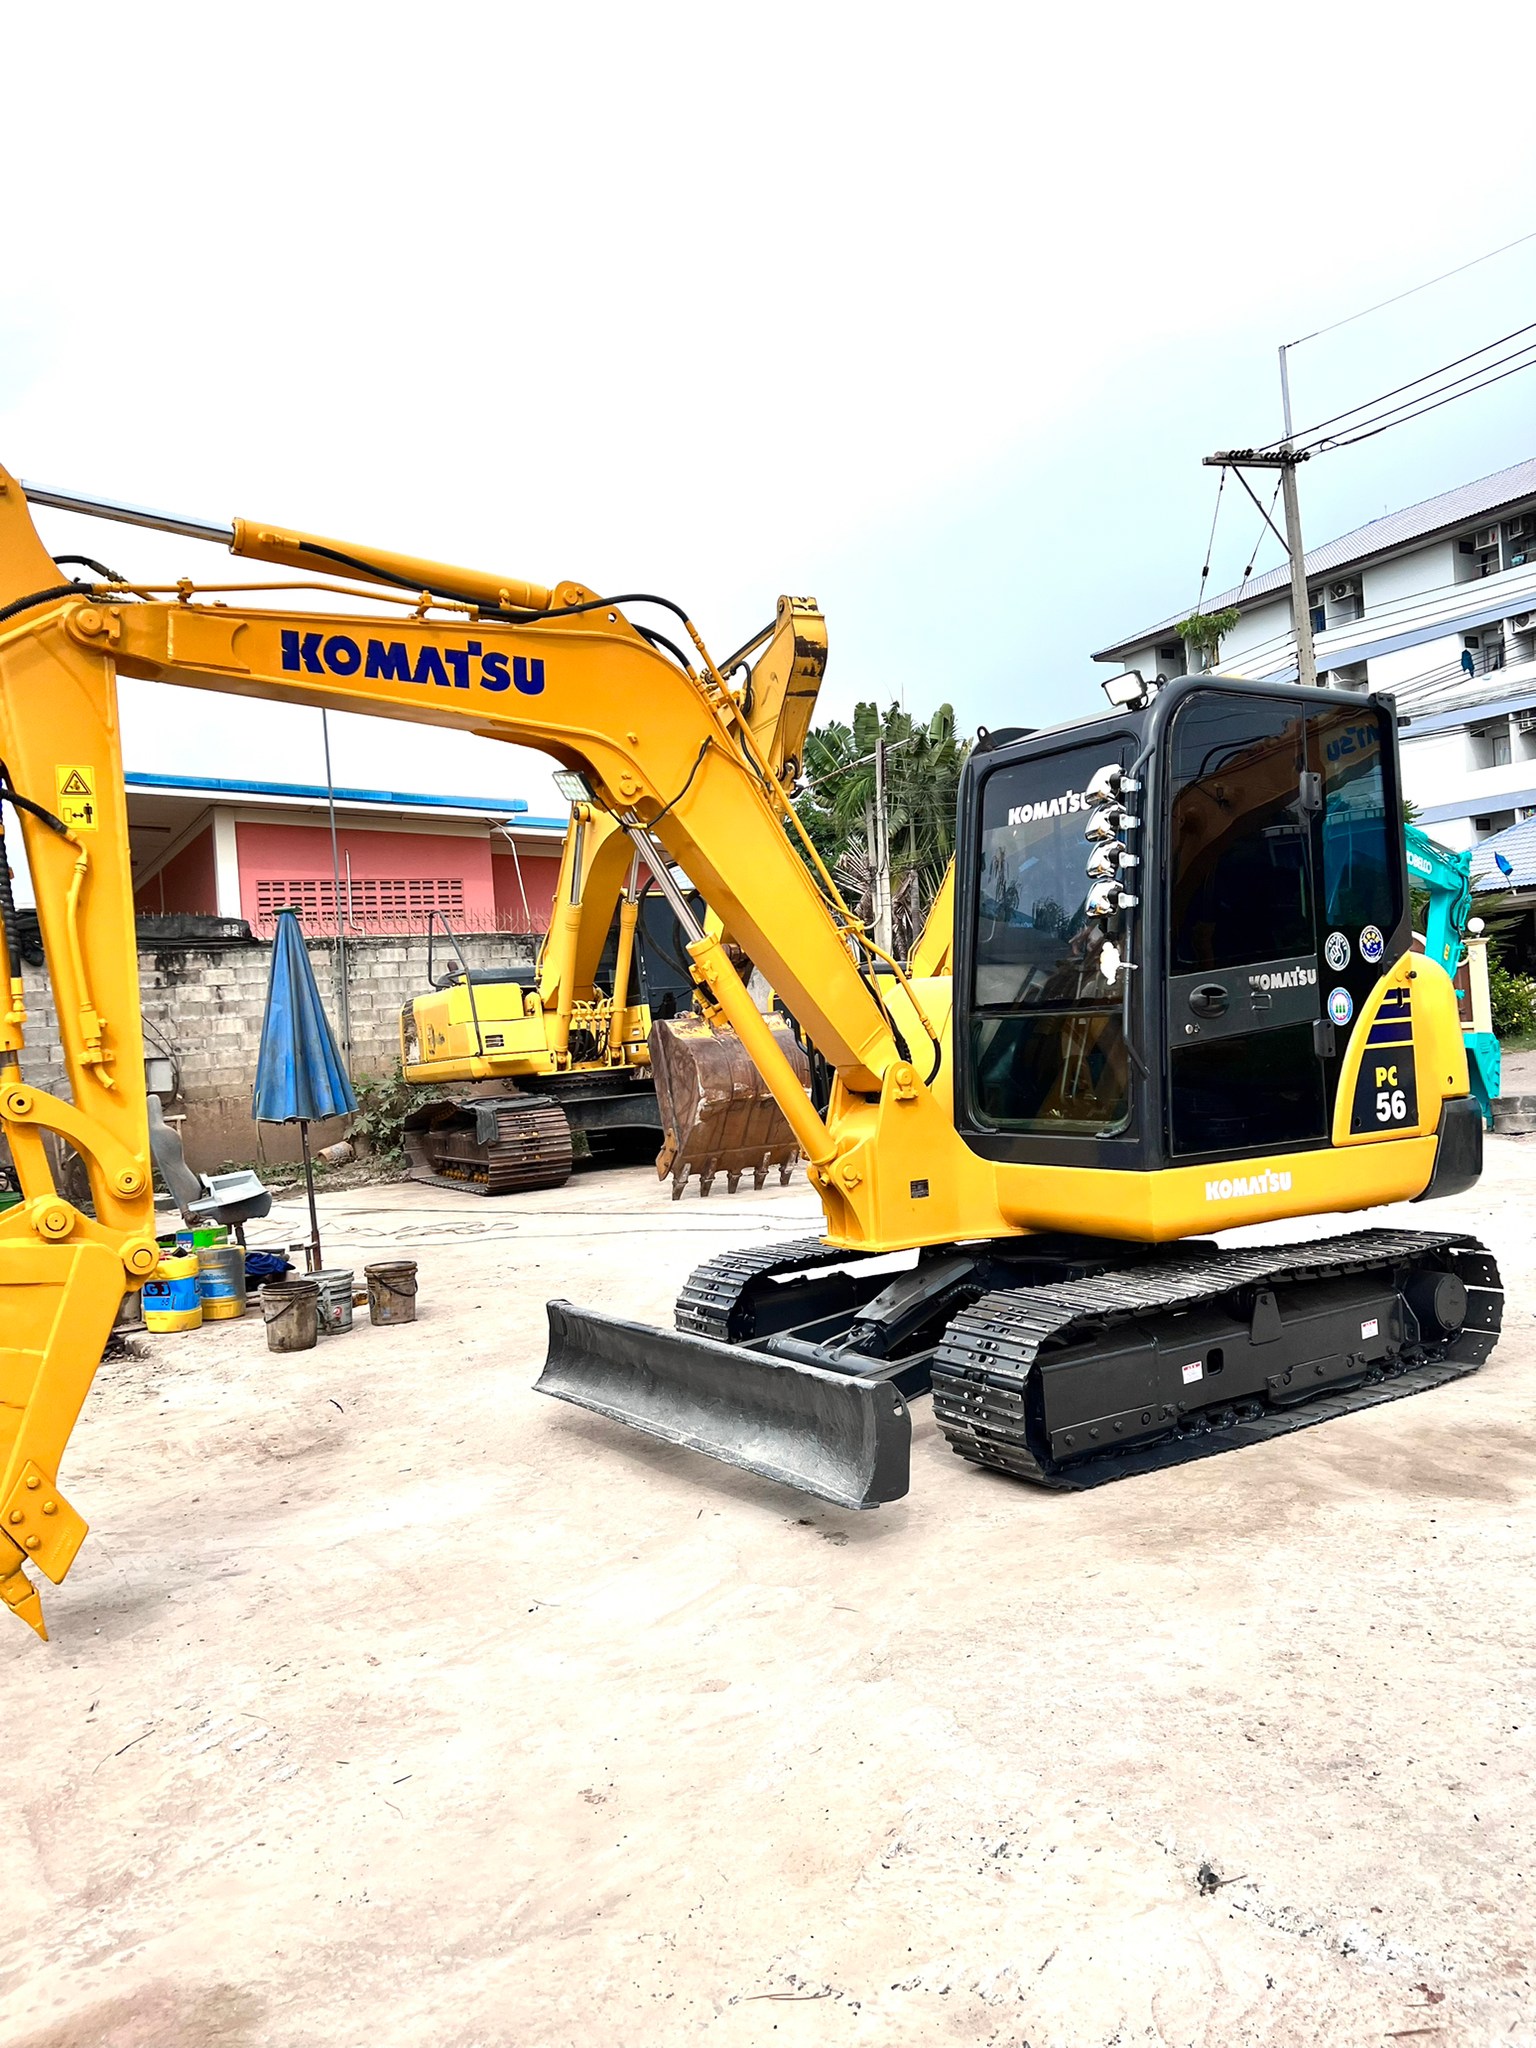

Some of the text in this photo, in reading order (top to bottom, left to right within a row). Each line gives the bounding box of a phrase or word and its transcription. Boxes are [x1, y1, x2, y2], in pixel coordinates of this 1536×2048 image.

[281, 629, 545, 695] KOMATSU
[1249, 966, 1317, 991] KOMATSU
[1375, 1065, 1398, 1088] PC
[1375, 1089, 1407, 1122] 56
[1205, 1168, 1292, 1201] KOMATSU
